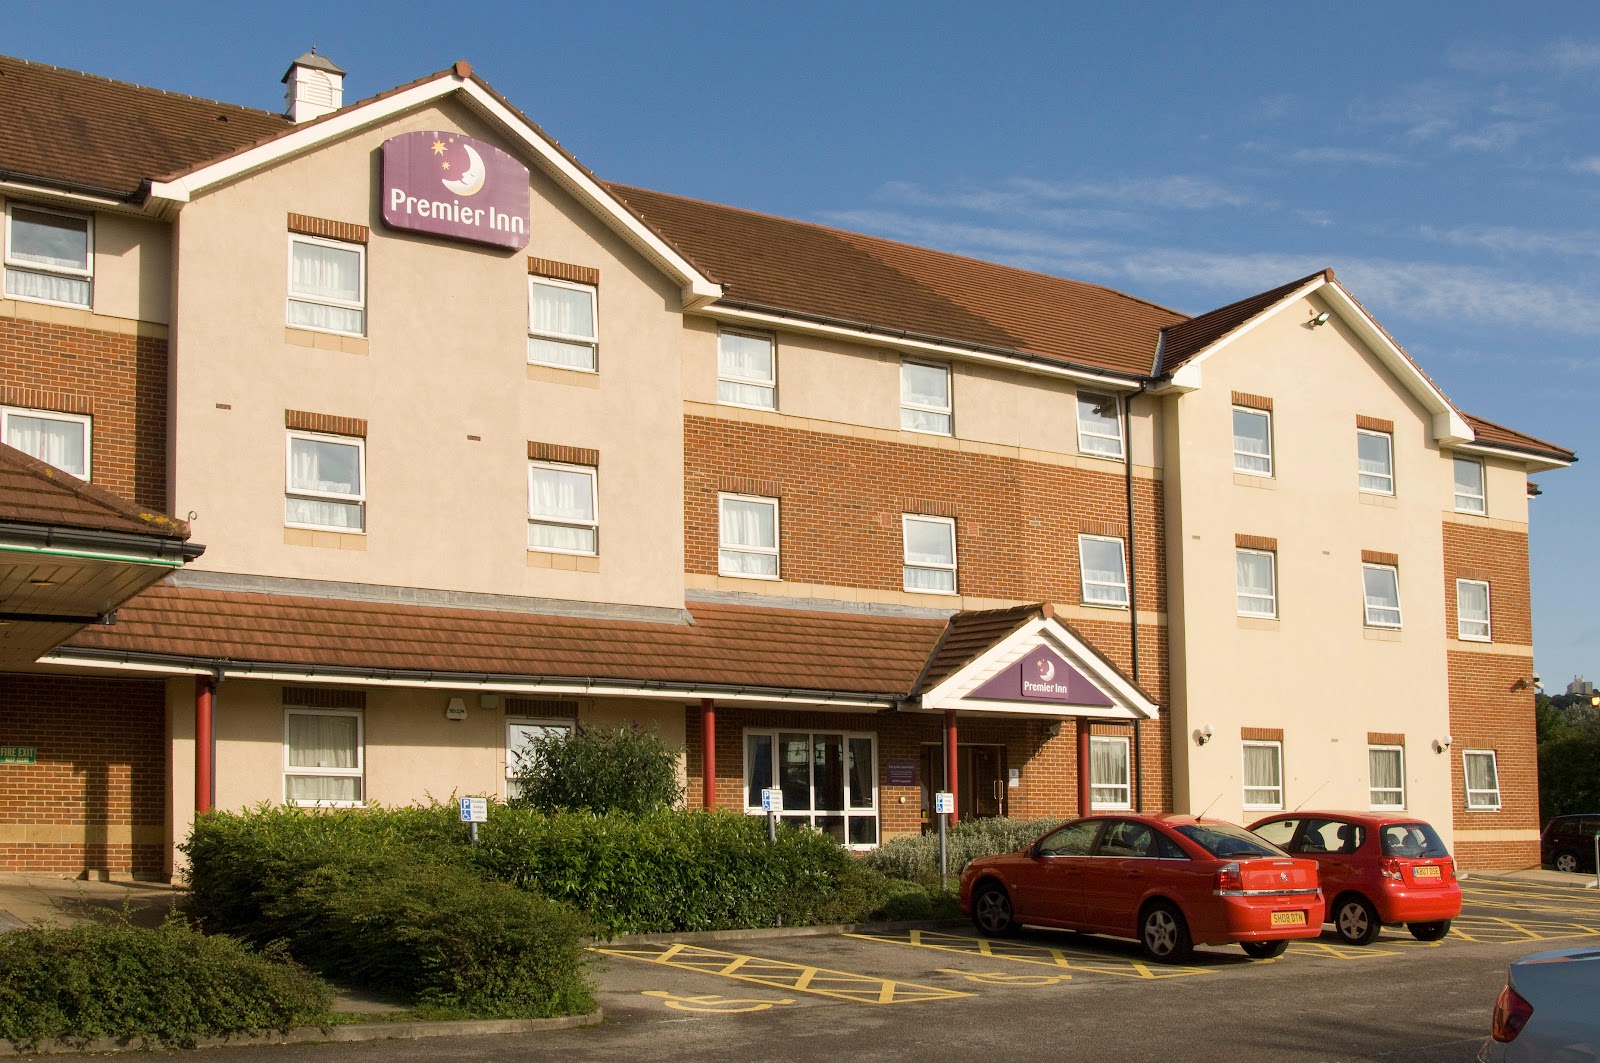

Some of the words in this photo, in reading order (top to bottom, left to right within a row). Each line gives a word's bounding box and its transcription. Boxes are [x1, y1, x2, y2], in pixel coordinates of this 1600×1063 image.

[391, 188, 485, 226] Premier
[489, 206, 524, 234] Inn
[1024, 680, 1055, 693] Premier
[1055, 683, 1068, 694] Inn
[0, 747, 17, 757] FIRE
[18, 747, 33, 757] EXIT
[764, 791, 770, 800] P
[463, 799, 470, 809] P
